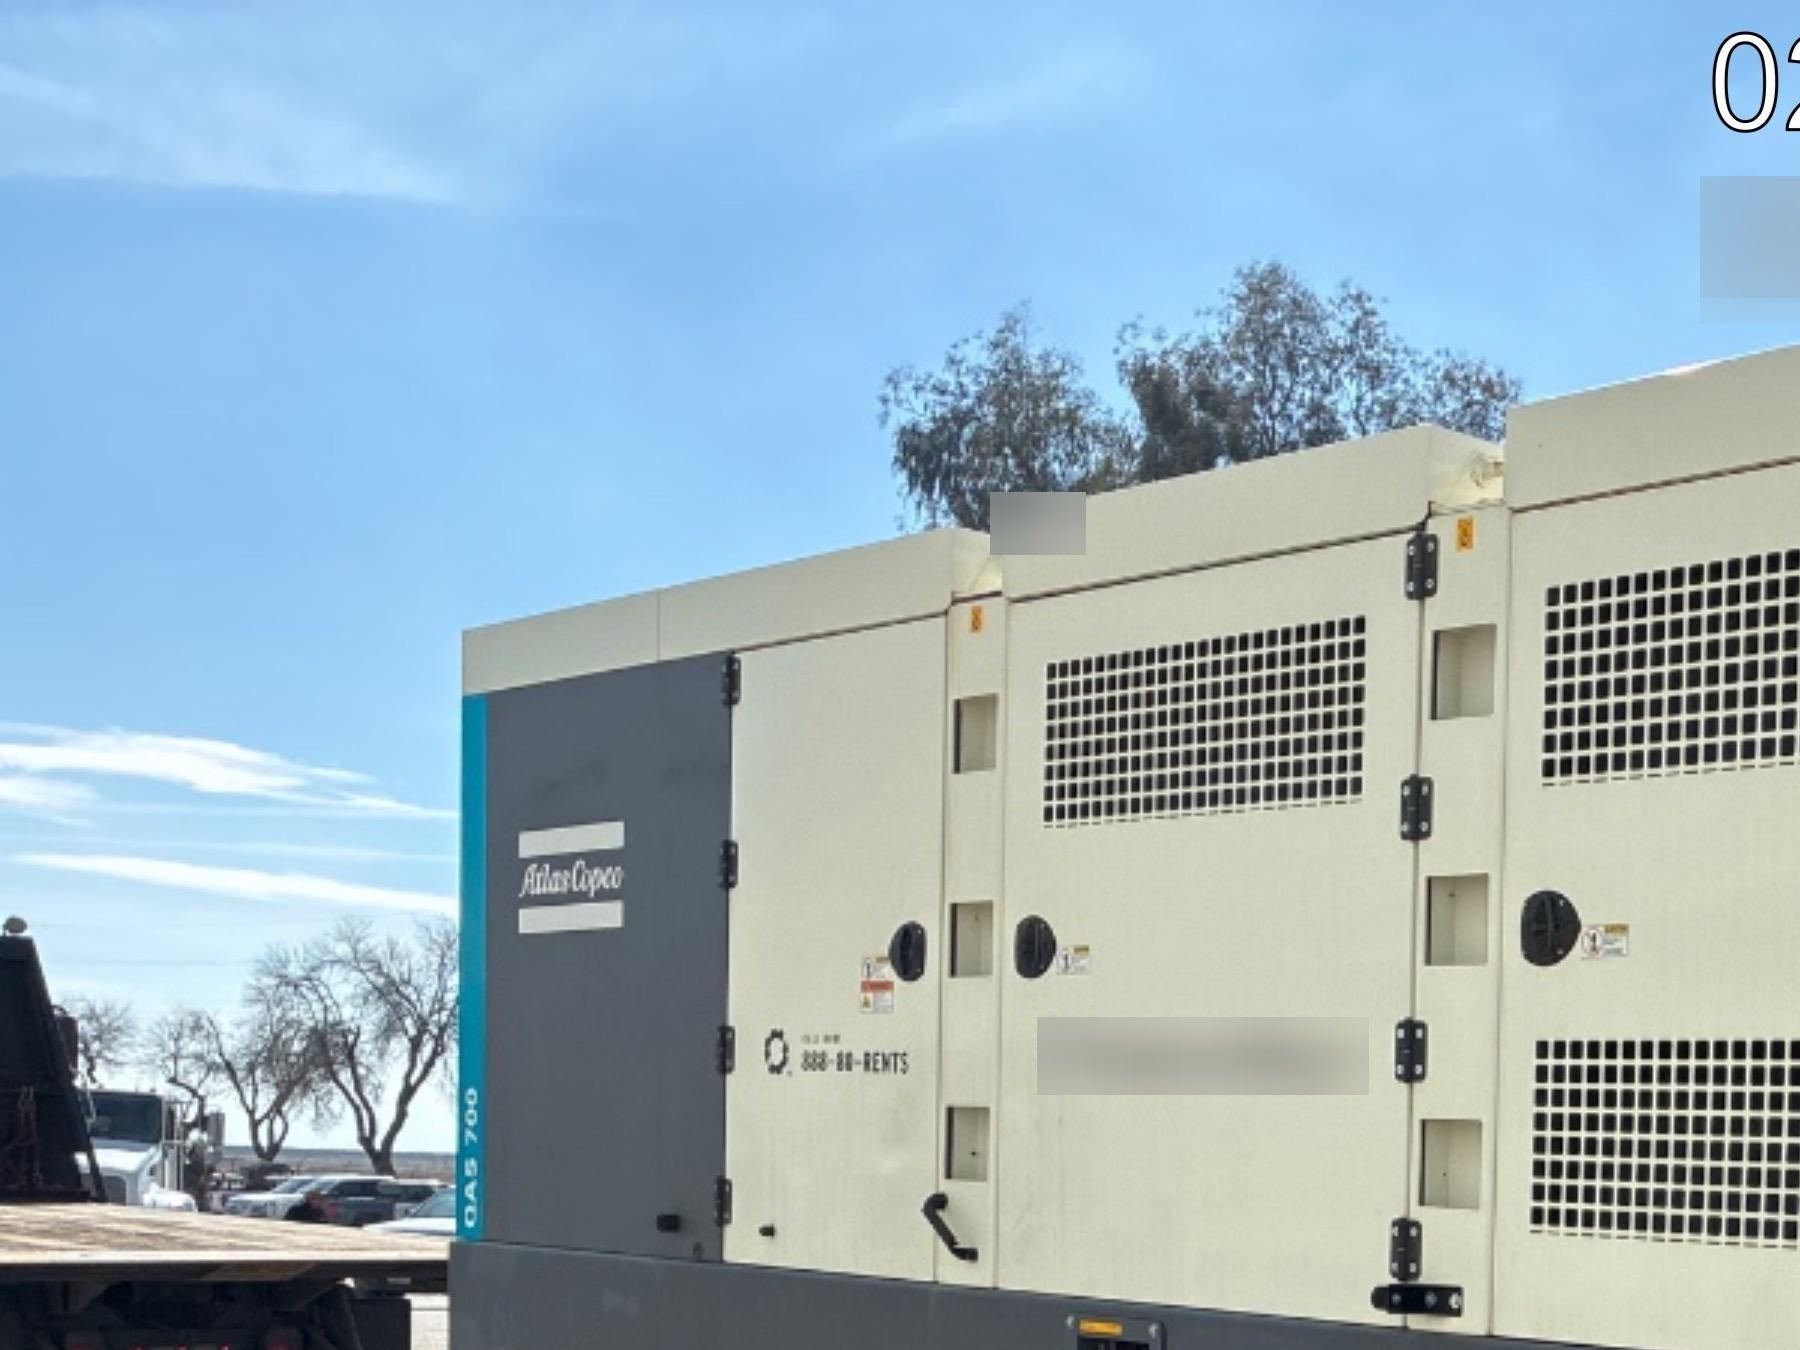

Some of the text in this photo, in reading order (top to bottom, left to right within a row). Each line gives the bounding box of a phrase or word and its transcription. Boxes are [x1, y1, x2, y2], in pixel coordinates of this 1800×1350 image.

[518, 858, 624, 898] Atlas Copco
[463, 1087, 478, 1147] 700
